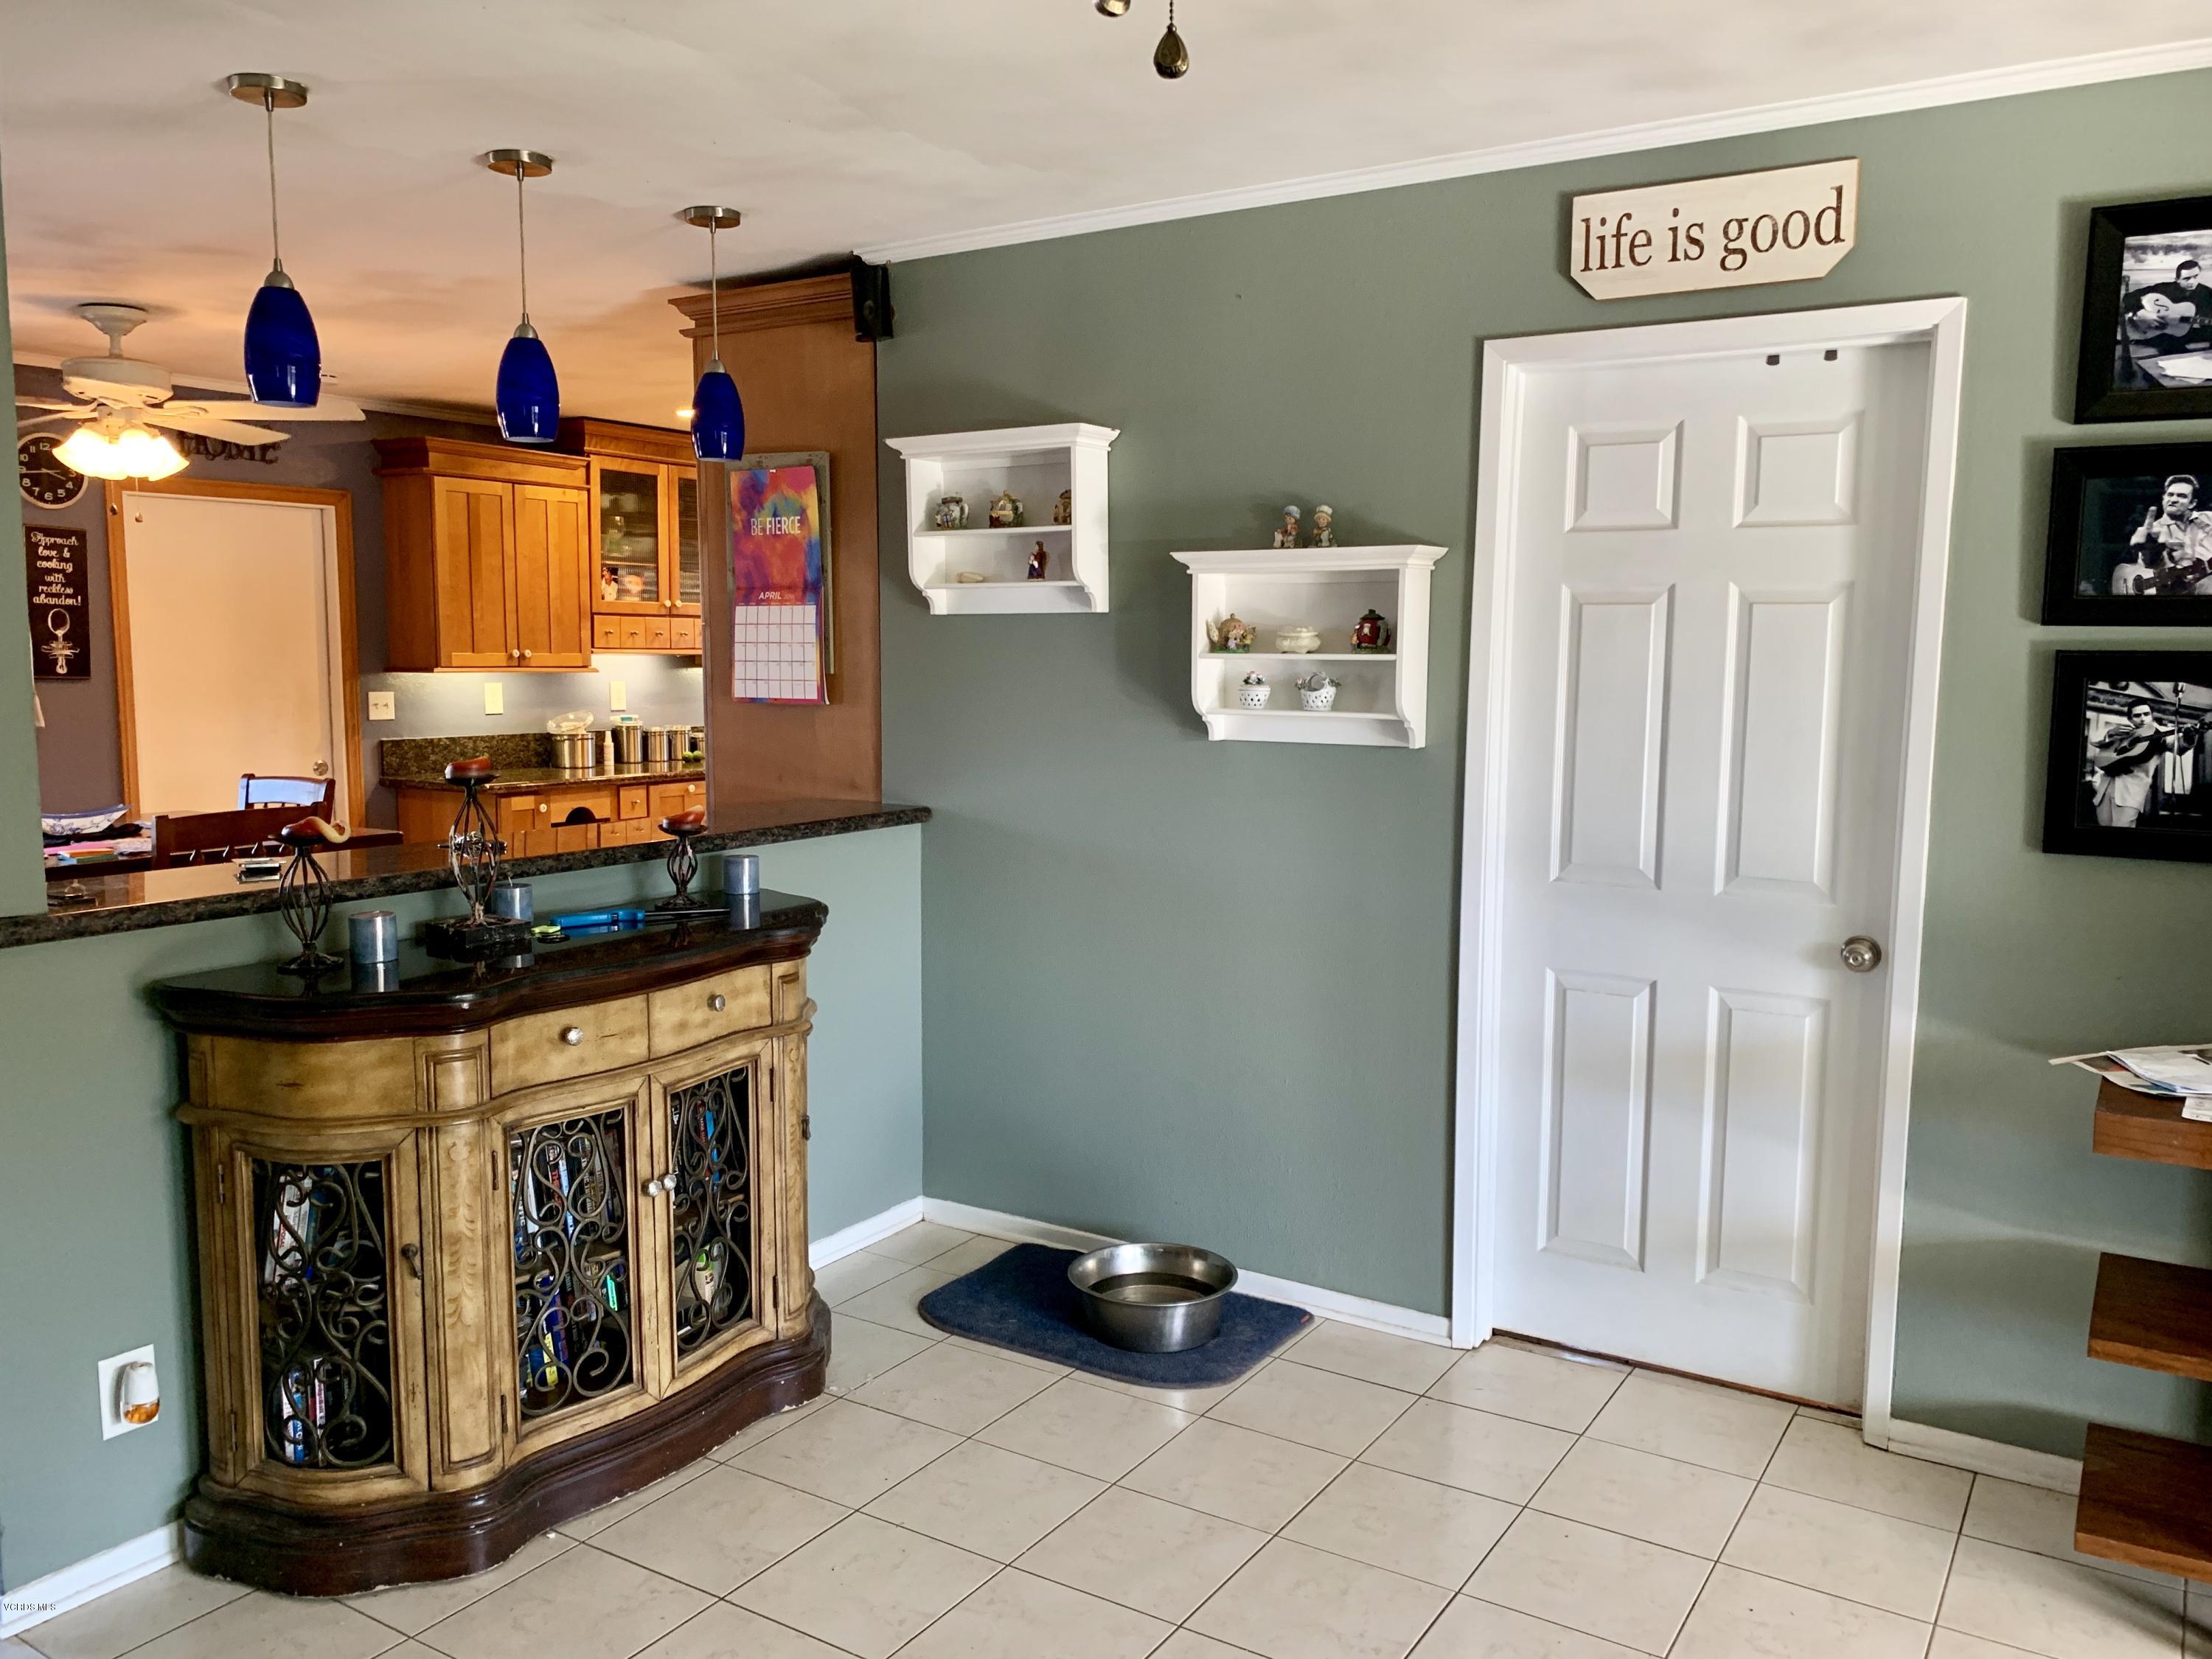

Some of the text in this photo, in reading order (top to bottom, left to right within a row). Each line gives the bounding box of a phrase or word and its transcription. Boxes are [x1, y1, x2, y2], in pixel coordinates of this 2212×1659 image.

[1579, 184, 1846, 272] life is good
[39, 442, 50, 451] 12
[20, 453, 28, 462] 10
[22, 478, 31, 487] 8
[66, 481, 73, 489] 4
[32, 487, 40, 495] 7
[57, 489, 66, 497] 5
[751, 516, 801, 536] BE FIERCE
[31, 531, 79, 546] Approach
[38, 546, 70, 558] love &
[37, 558, 73, 573] cooking
[45, 572, 66, 583] with
[39, 583, 74, 594] reckless
[33, 593, 81, 605] abandon!
[759, 591, 782, 600] APRIL
